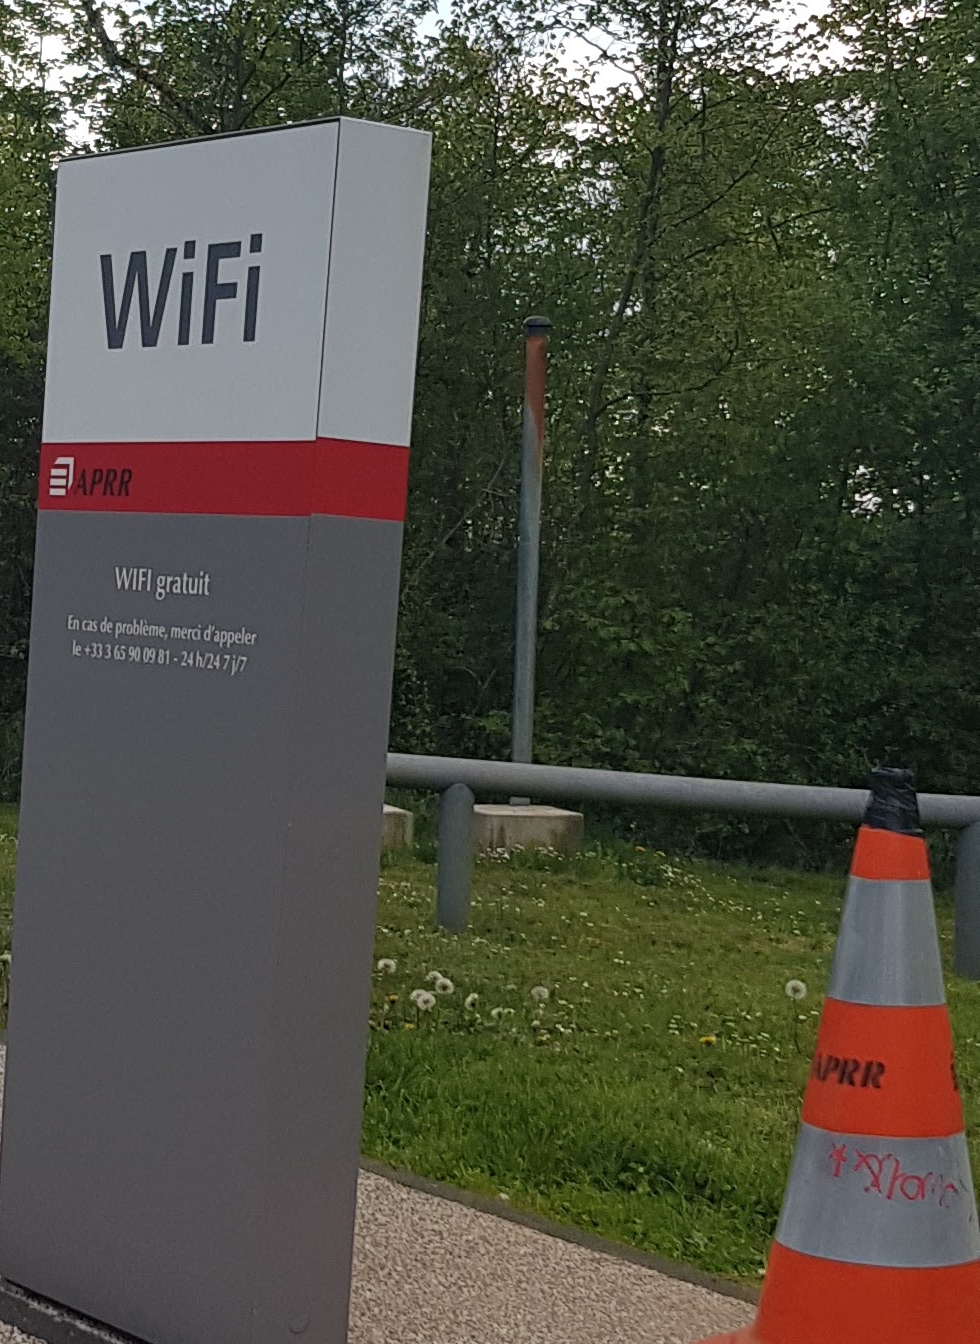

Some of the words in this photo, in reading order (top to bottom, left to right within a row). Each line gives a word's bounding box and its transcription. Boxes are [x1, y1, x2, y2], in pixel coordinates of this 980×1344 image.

[100, 233, 263, 349] WiFi
[74, 468, 133, 497] APRR
[114, 566, 151, 592] WIFI
[155, 570, 210, 600] gratuit
[67, 614, 80, 630] En
[82, 619, 98, 632] cas
[100, 616, 113, 633] de
[115, 618, 168, 640] problème,
[170, 624, 201, 641] merci
[203, 624, 257, 648] d'appeler
[72, 640, 82, 656] le
[84, 642, 103, 658] +33
[104, 644, 112, 659] 3
[113, 644, 126, 660] 65
[128, 646, 141, 662] 90
[142, 647, 156, 663] 09
[157, 649, 170, 665] 81
[180, 651, 194, 667] 24
